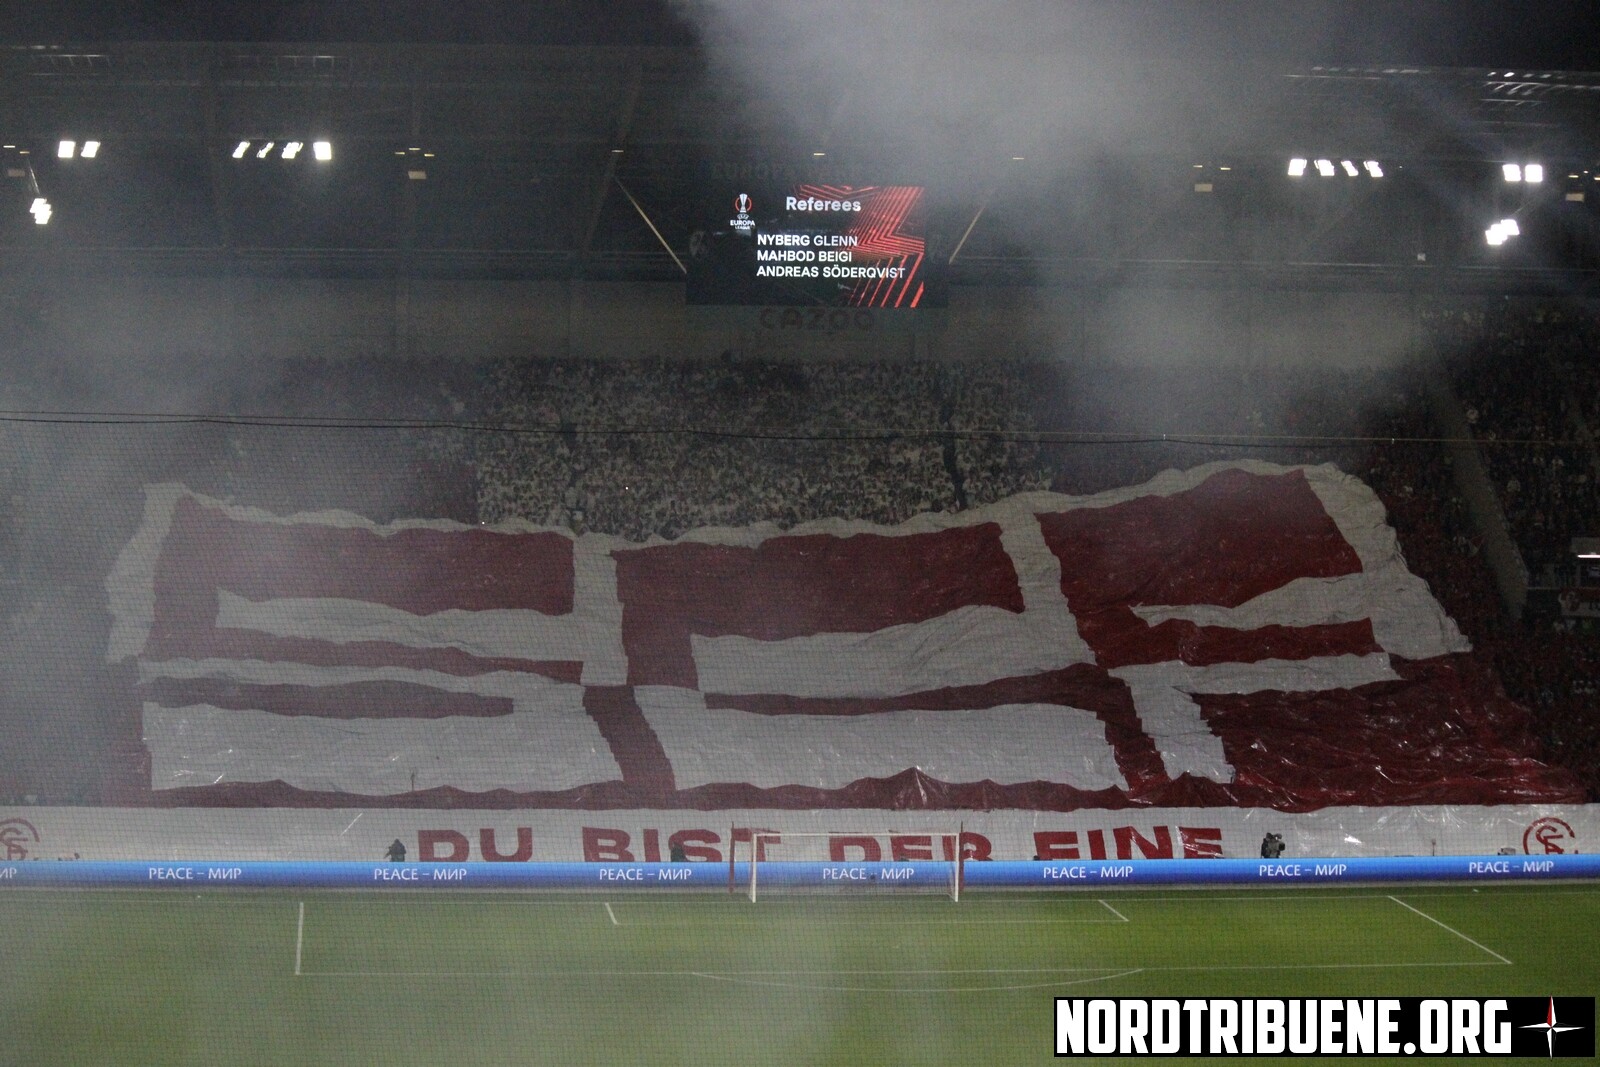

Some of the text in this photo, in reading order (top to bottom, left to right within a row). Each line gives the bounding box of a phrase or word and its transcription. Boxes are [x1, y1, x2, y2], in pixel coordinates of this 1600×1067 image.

[786, 195, 862, 212] Referees
[757, 234, 858, 247] NYBERG GLENN
[757, 249, 852, 262] MAHBOD BEIGI
[756, 264, 906, 279] ANDREAS SÖDERQVIST
[417, 825, 1225, 862] DU BIST DER EINE
[0, 867, 17, 879] ИР
[1044, 867, 1086, 878] PEACE
[1101, 866, 1133, 877] МИР
[1259, 865, 1301, 876] PEACE
[1315, 864, 1347, 875] МИР
[1469, 861, 1509, 873] PEACE
[1523, 861, 1554, 872] МИР
[150, 868, 192, 879] PEACE
[209, 868, 241, 879] МИР
[374, 869, 417, 880] PEACE
[434, 869, 467, 880] МИР
[600, 869, 642, 880] PEACE
[659, 869, 692, 880] МИР
[823, 868, 866, 880] PEACE
